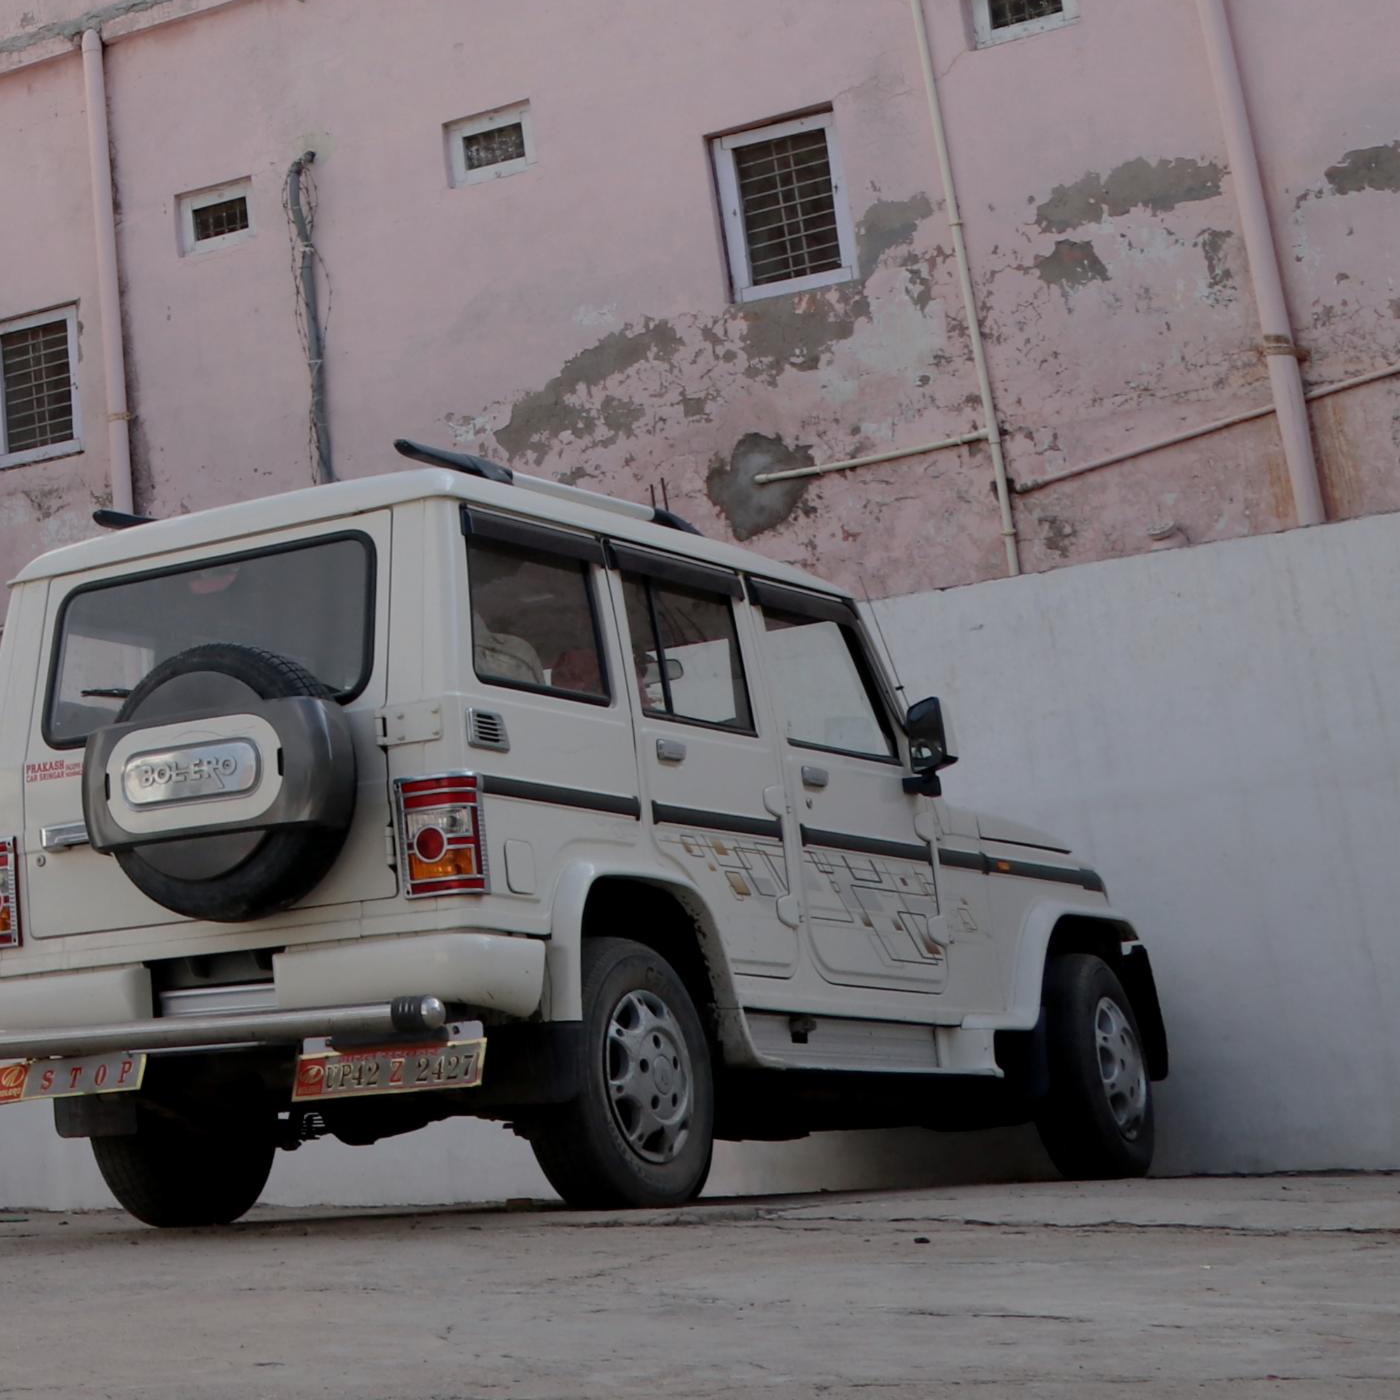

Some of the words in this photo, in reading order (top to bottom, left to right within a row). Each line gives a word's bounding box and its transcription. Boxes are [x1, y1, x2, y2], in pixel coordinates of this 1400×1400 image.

[25, 760, 65, 775] PRAKASH
[25, 774, 38, 783] CAR
[139, 755, 238, 790] BOLERO
[325, 1061, 380, 1090] UP42
[415, 1053, 477, 1085] 2427
